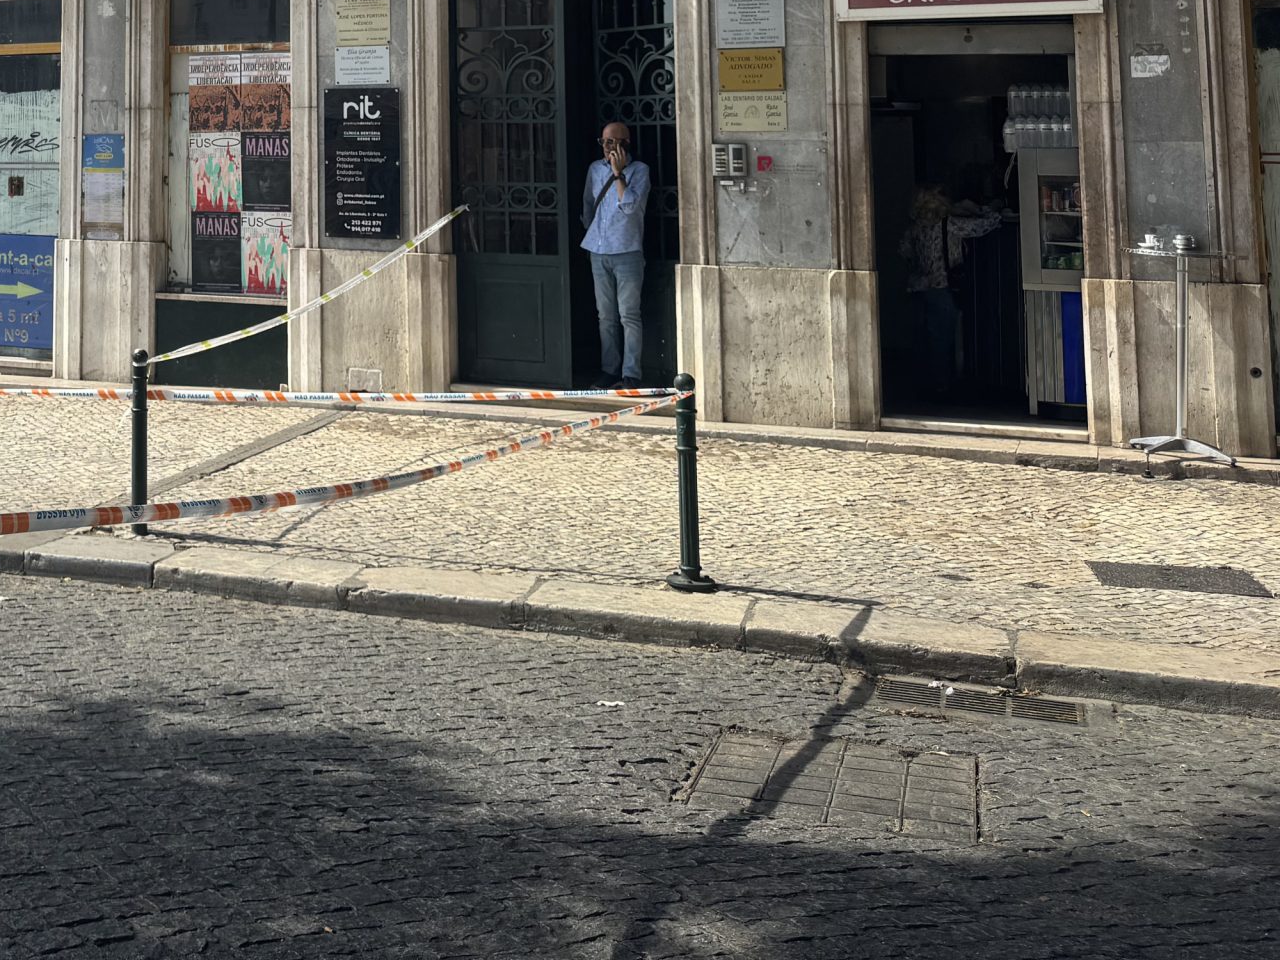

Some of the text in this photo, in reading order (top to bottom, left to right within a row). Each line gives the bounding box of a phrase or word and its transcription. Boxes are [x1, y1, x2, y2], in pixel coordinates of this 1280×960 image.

[191, 63, 239, 73] INDEPENDÊNCIA
[196, 76, 233, 85] LIBERTAÇÃO
[249, 74, 287, 83] LIBERTAÇÃO
[343, 95, 381, 119] rit
[245, 138, 289, 156] MANAS
[196, 217, 239, 236] MANAS
[8, 309, 16, 323] 5
